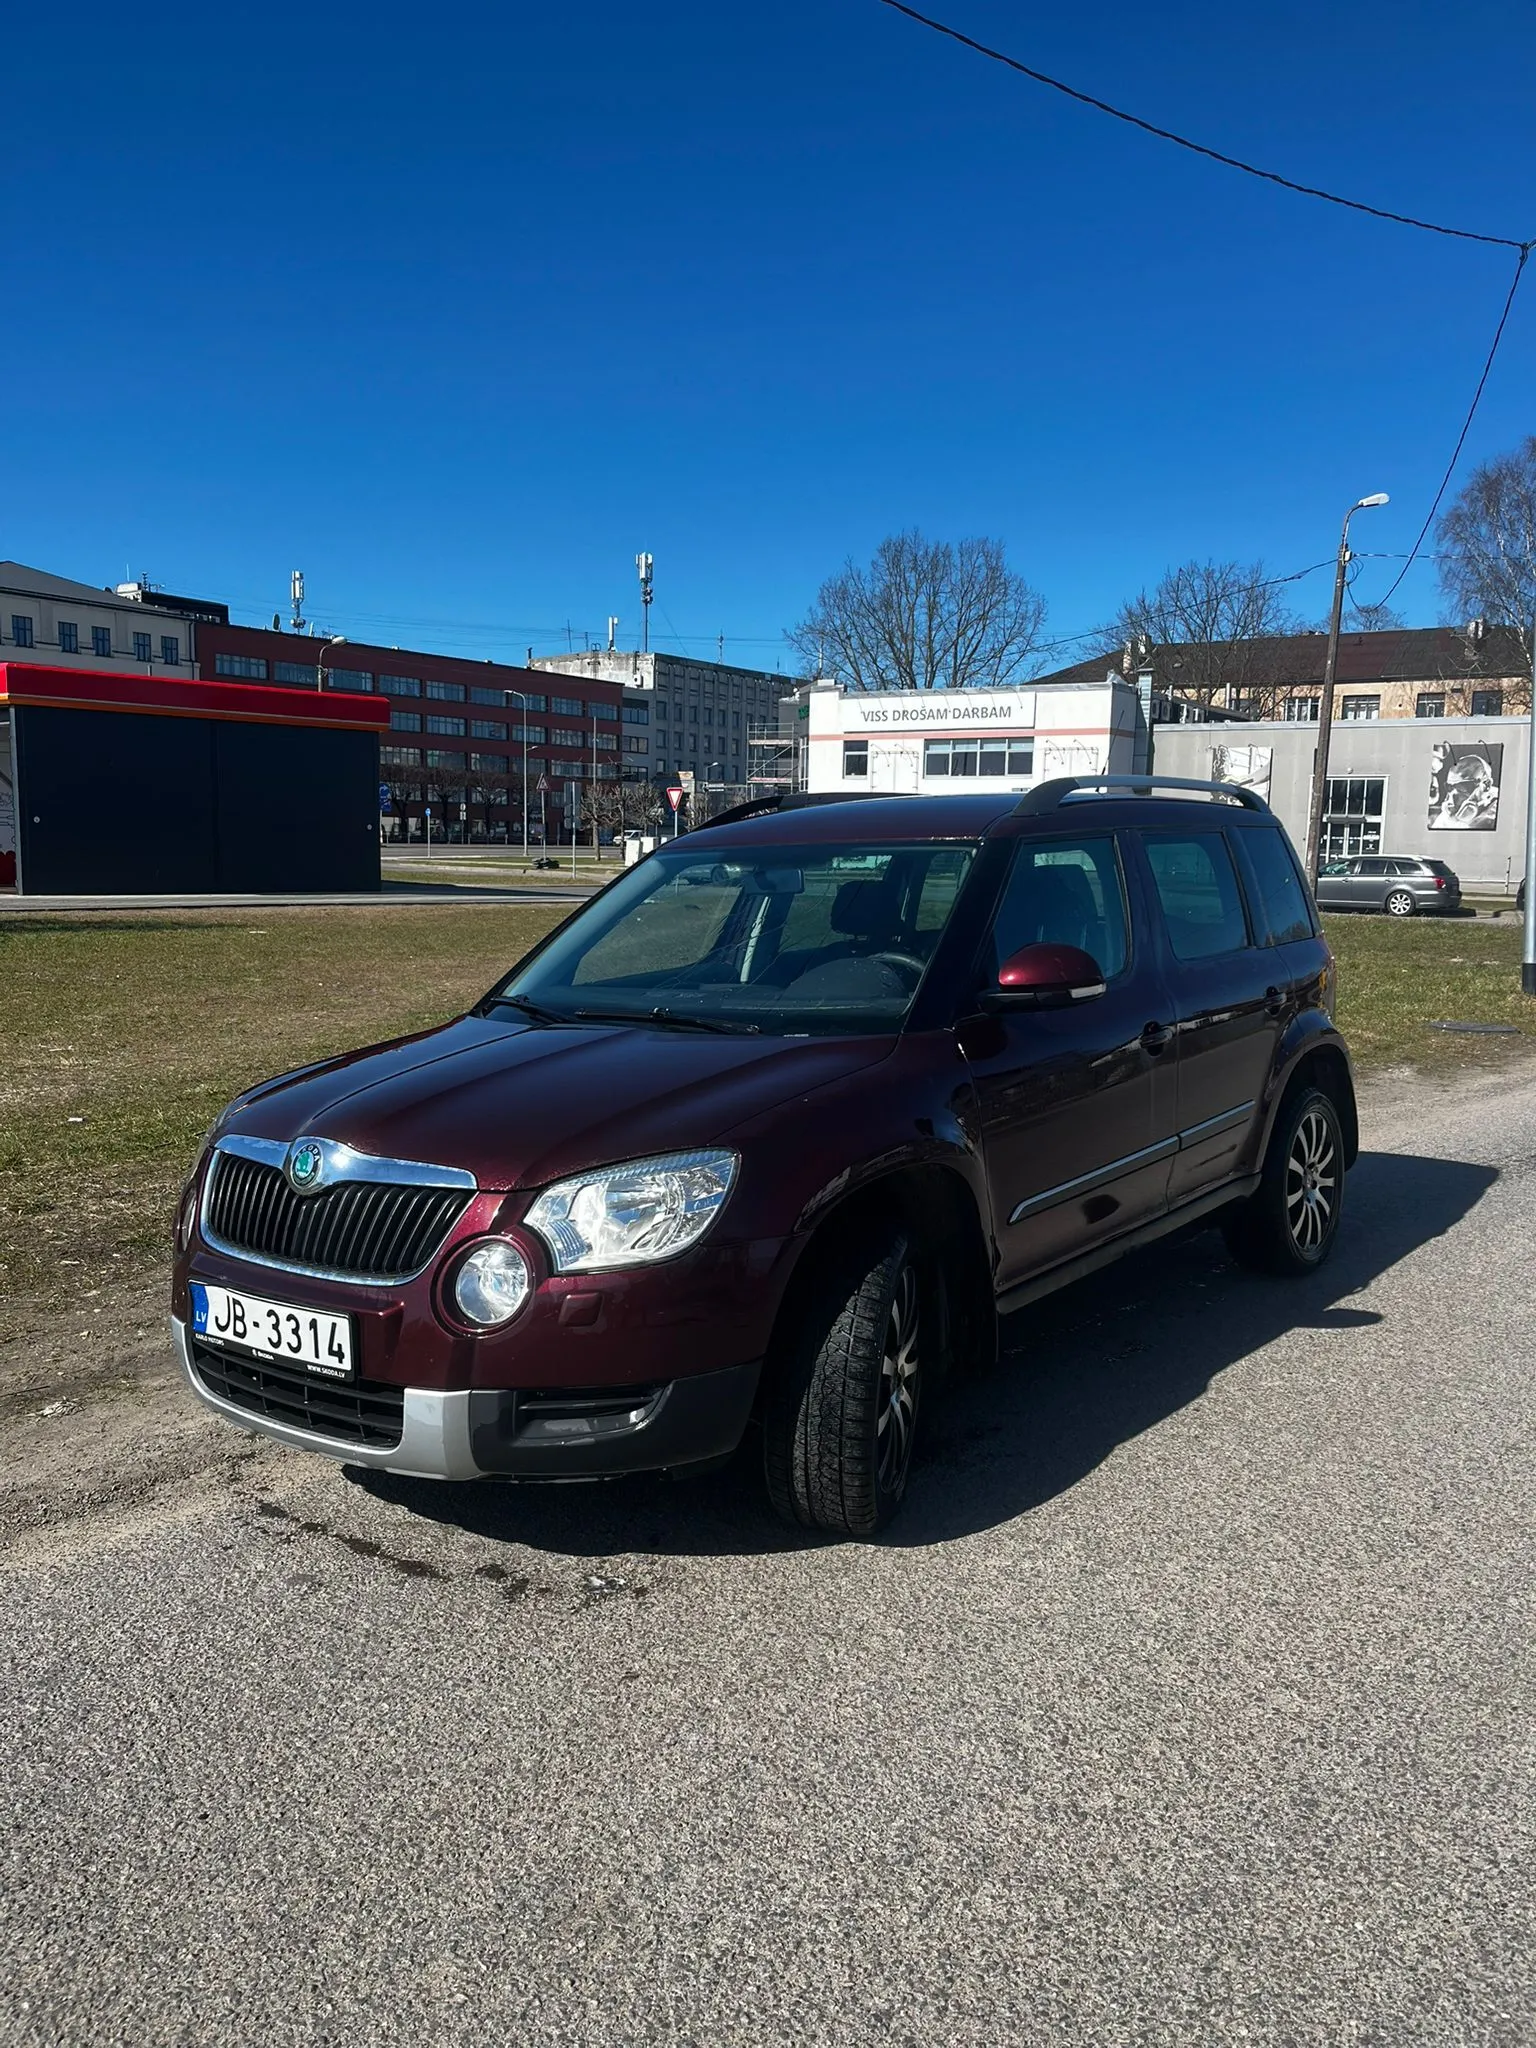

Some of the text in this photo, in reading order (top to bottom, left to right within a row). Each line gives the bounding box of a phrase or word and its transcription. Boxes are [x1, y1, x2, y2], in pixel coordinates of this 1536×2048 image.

[861, 705, 1012, 722] VISS DROŠAM DARBAM
[196, 1310, 207, 1323] LV
[214, 1295, 345, 1364] JB-3314
